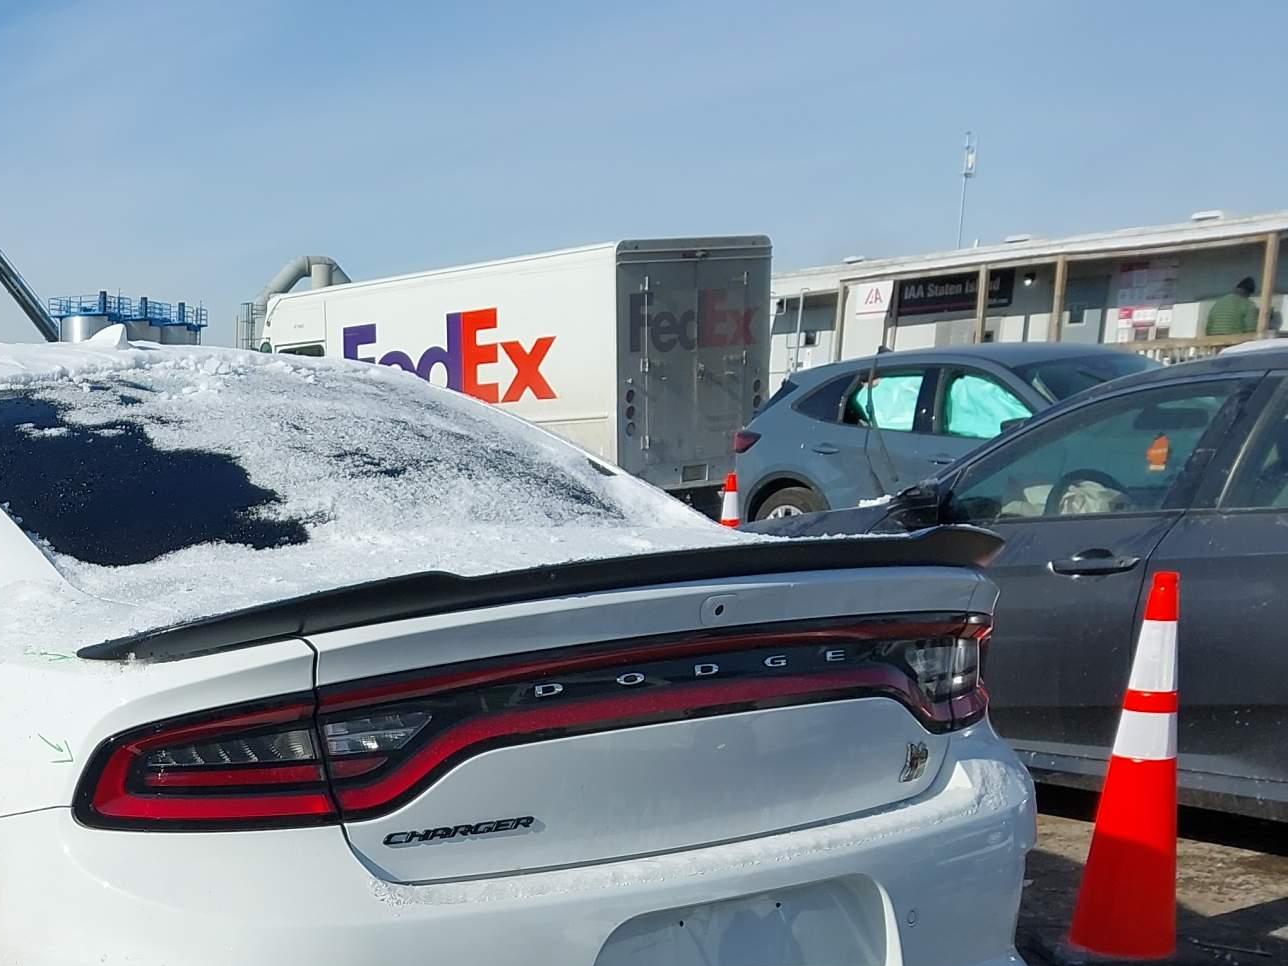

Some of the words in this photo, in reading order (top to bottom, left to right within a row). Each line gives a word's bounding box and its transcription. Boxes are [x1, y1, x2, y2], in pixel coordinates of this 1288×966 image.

[903, 285, 925, 300] IAA
[927, 281, 962, 298] Staten
[629, 288, 759, 352] FedEx
[534, 650, 846, 698] DODGE
[382, 816, 535, 846] CHARGER
